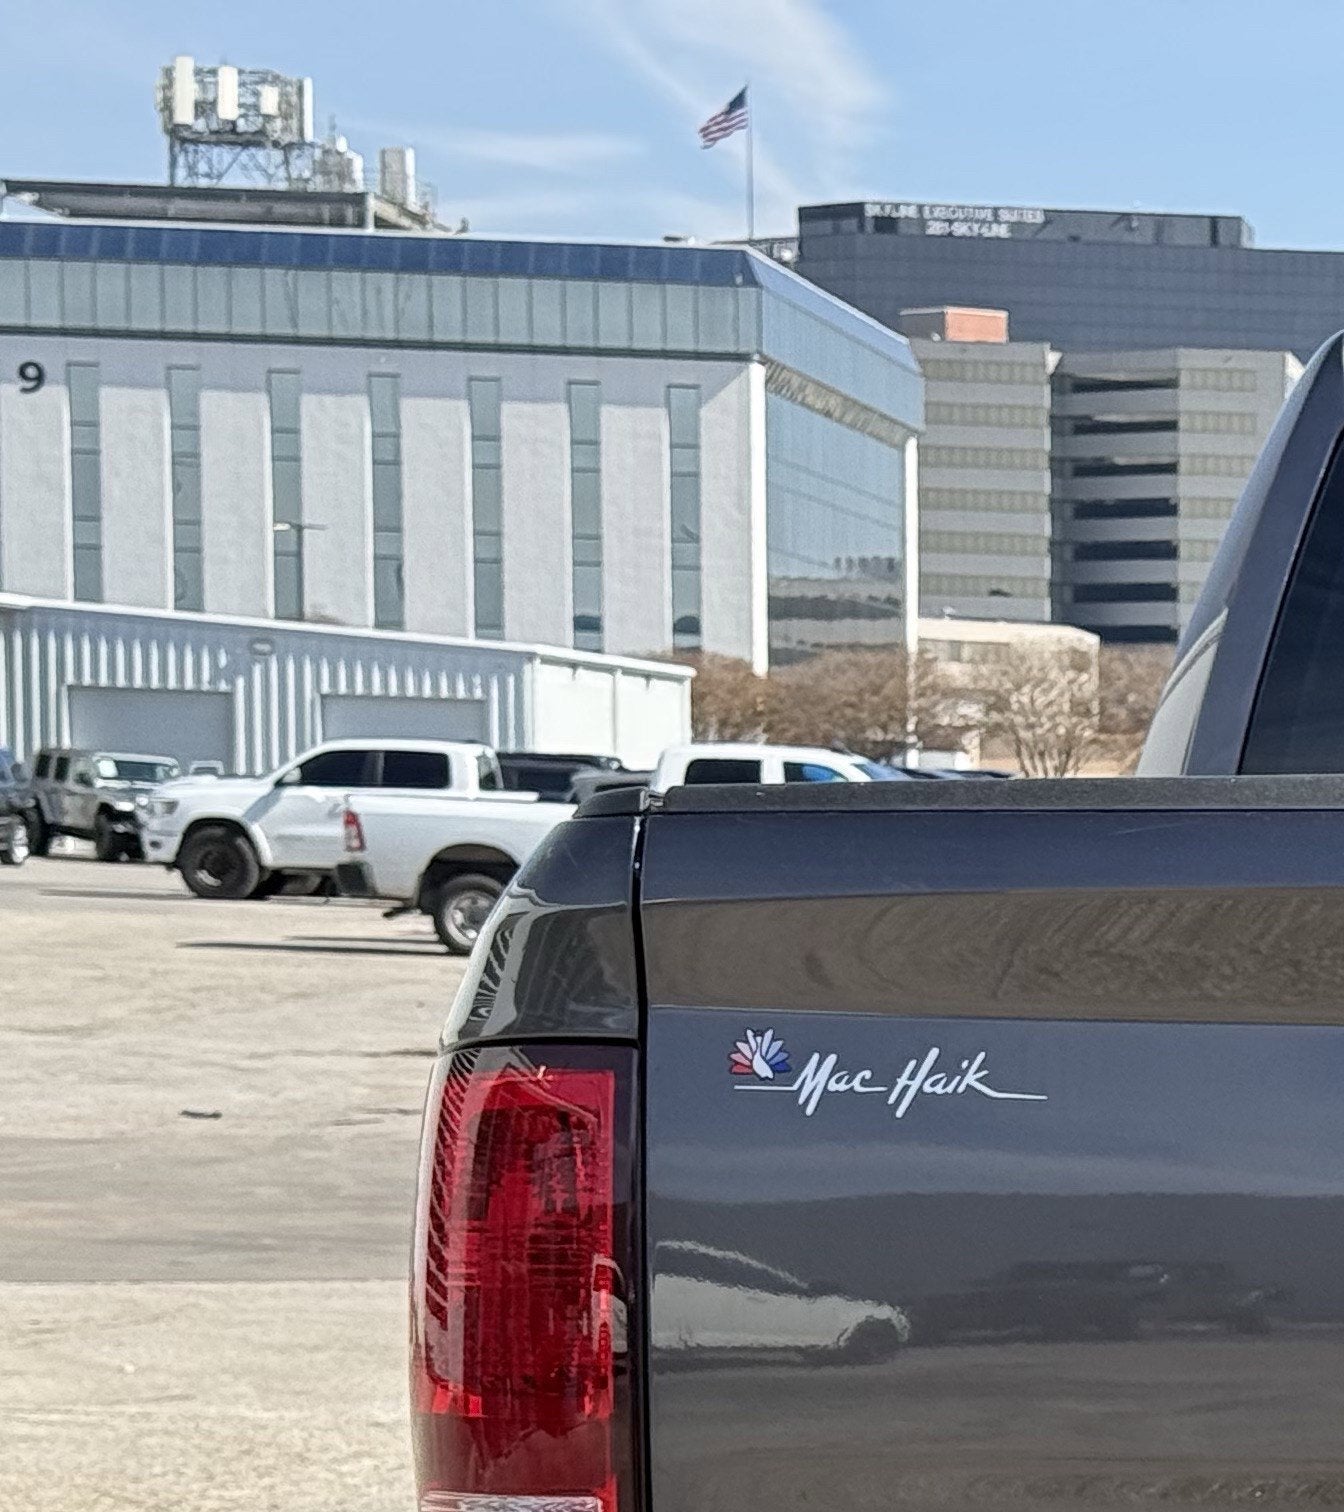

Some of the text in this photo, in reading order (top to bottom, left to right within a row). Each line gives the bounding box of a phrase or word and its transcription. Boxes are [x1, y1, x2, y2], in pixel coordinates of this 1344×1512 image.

[19, 361, 45, 394] 9
[734, 1046, 1048, 1118] Mac Haik
